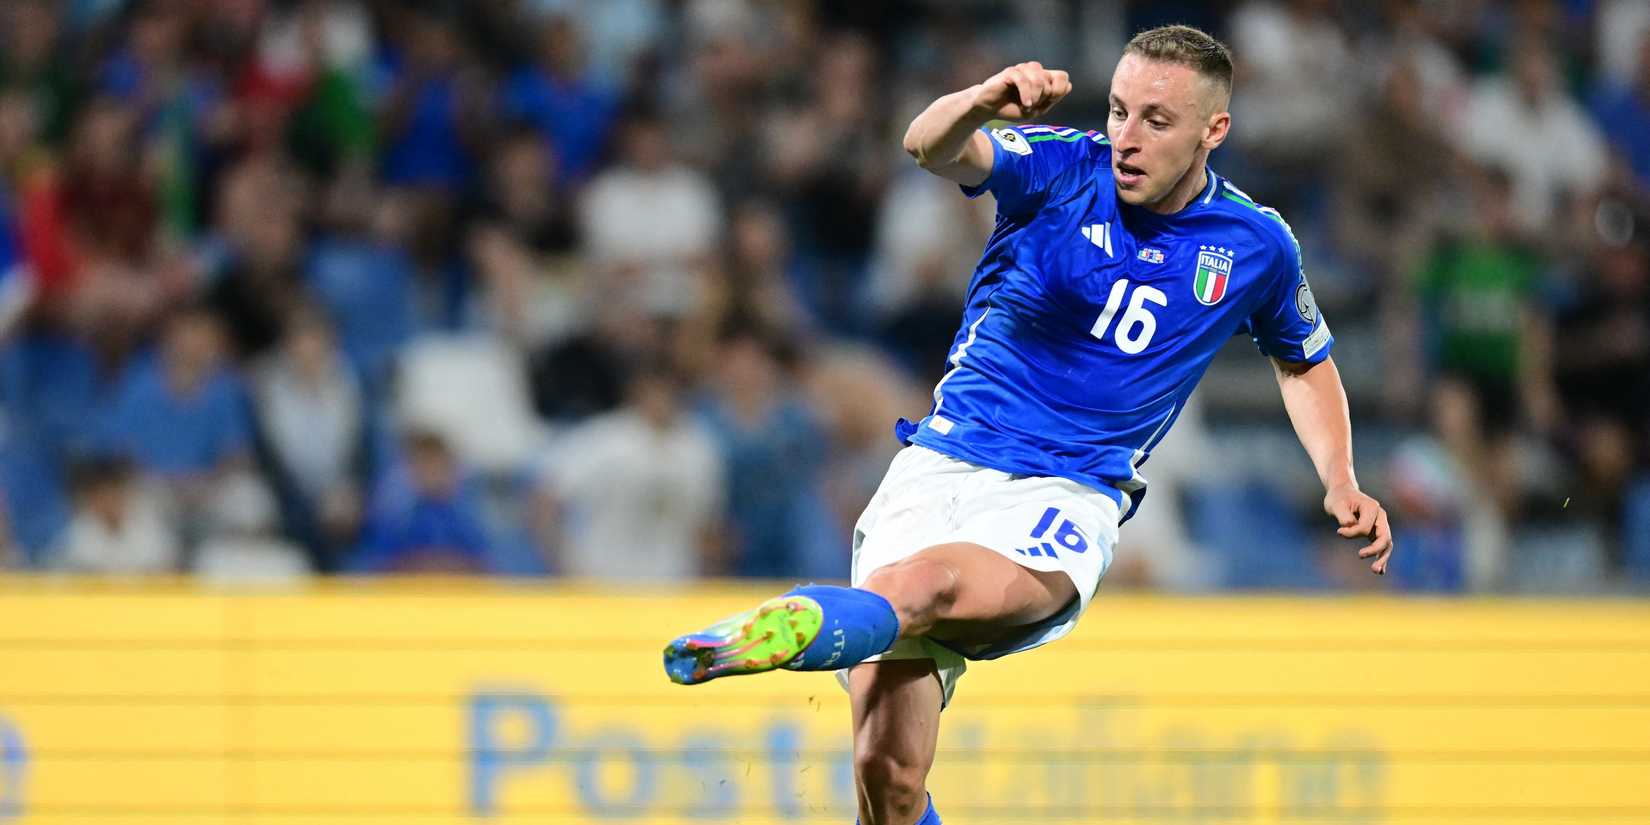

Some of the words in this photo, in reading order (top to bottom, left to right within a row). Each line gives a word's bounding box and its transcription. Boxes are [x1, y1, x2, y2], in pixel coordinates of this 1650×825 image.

[1201, 254, 1228, 272] ITALIA
[1090, 278, 1168, 354] 16
[1030, 507, 1089, 553] 16
